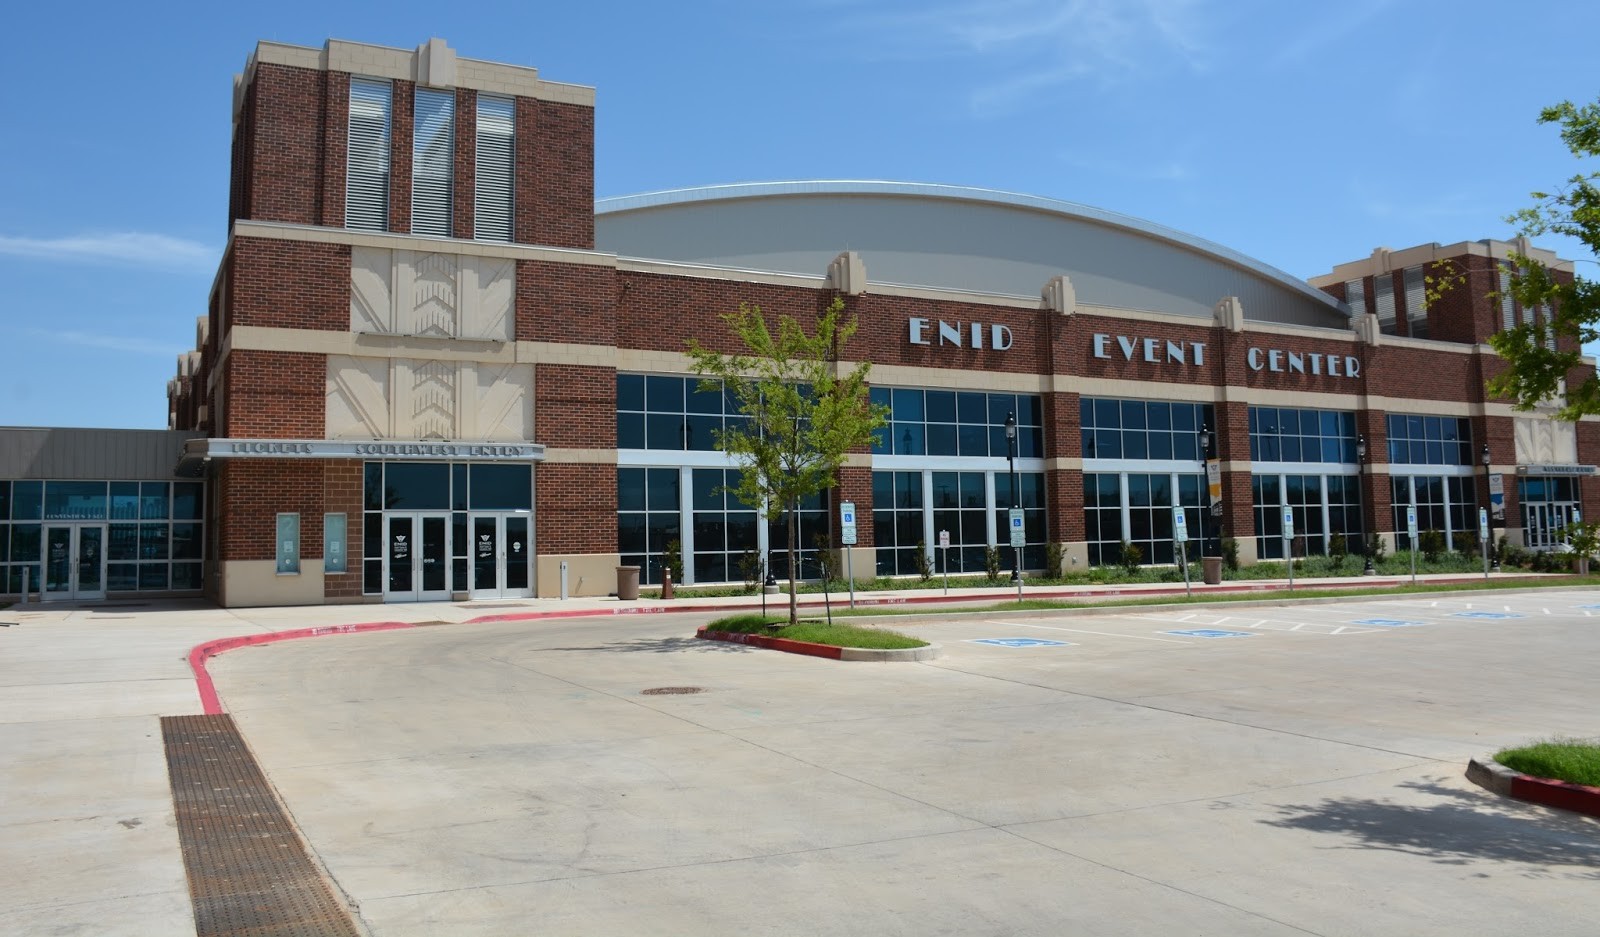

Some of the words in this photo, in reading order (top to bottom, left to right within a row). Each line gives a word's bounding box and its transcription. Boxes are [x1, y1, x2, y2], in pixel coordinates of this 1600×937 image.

[909, 317, 1013, 350] ENID
[1093, 333, 1207, 366] EVENT
[1247, 347, 1361, 378] CENTER
[232, 443, 315, 454] TICKETS
[356, 444, 461, 455] SOUTHWEST
[471, 446, 525, 456] ENTRY
